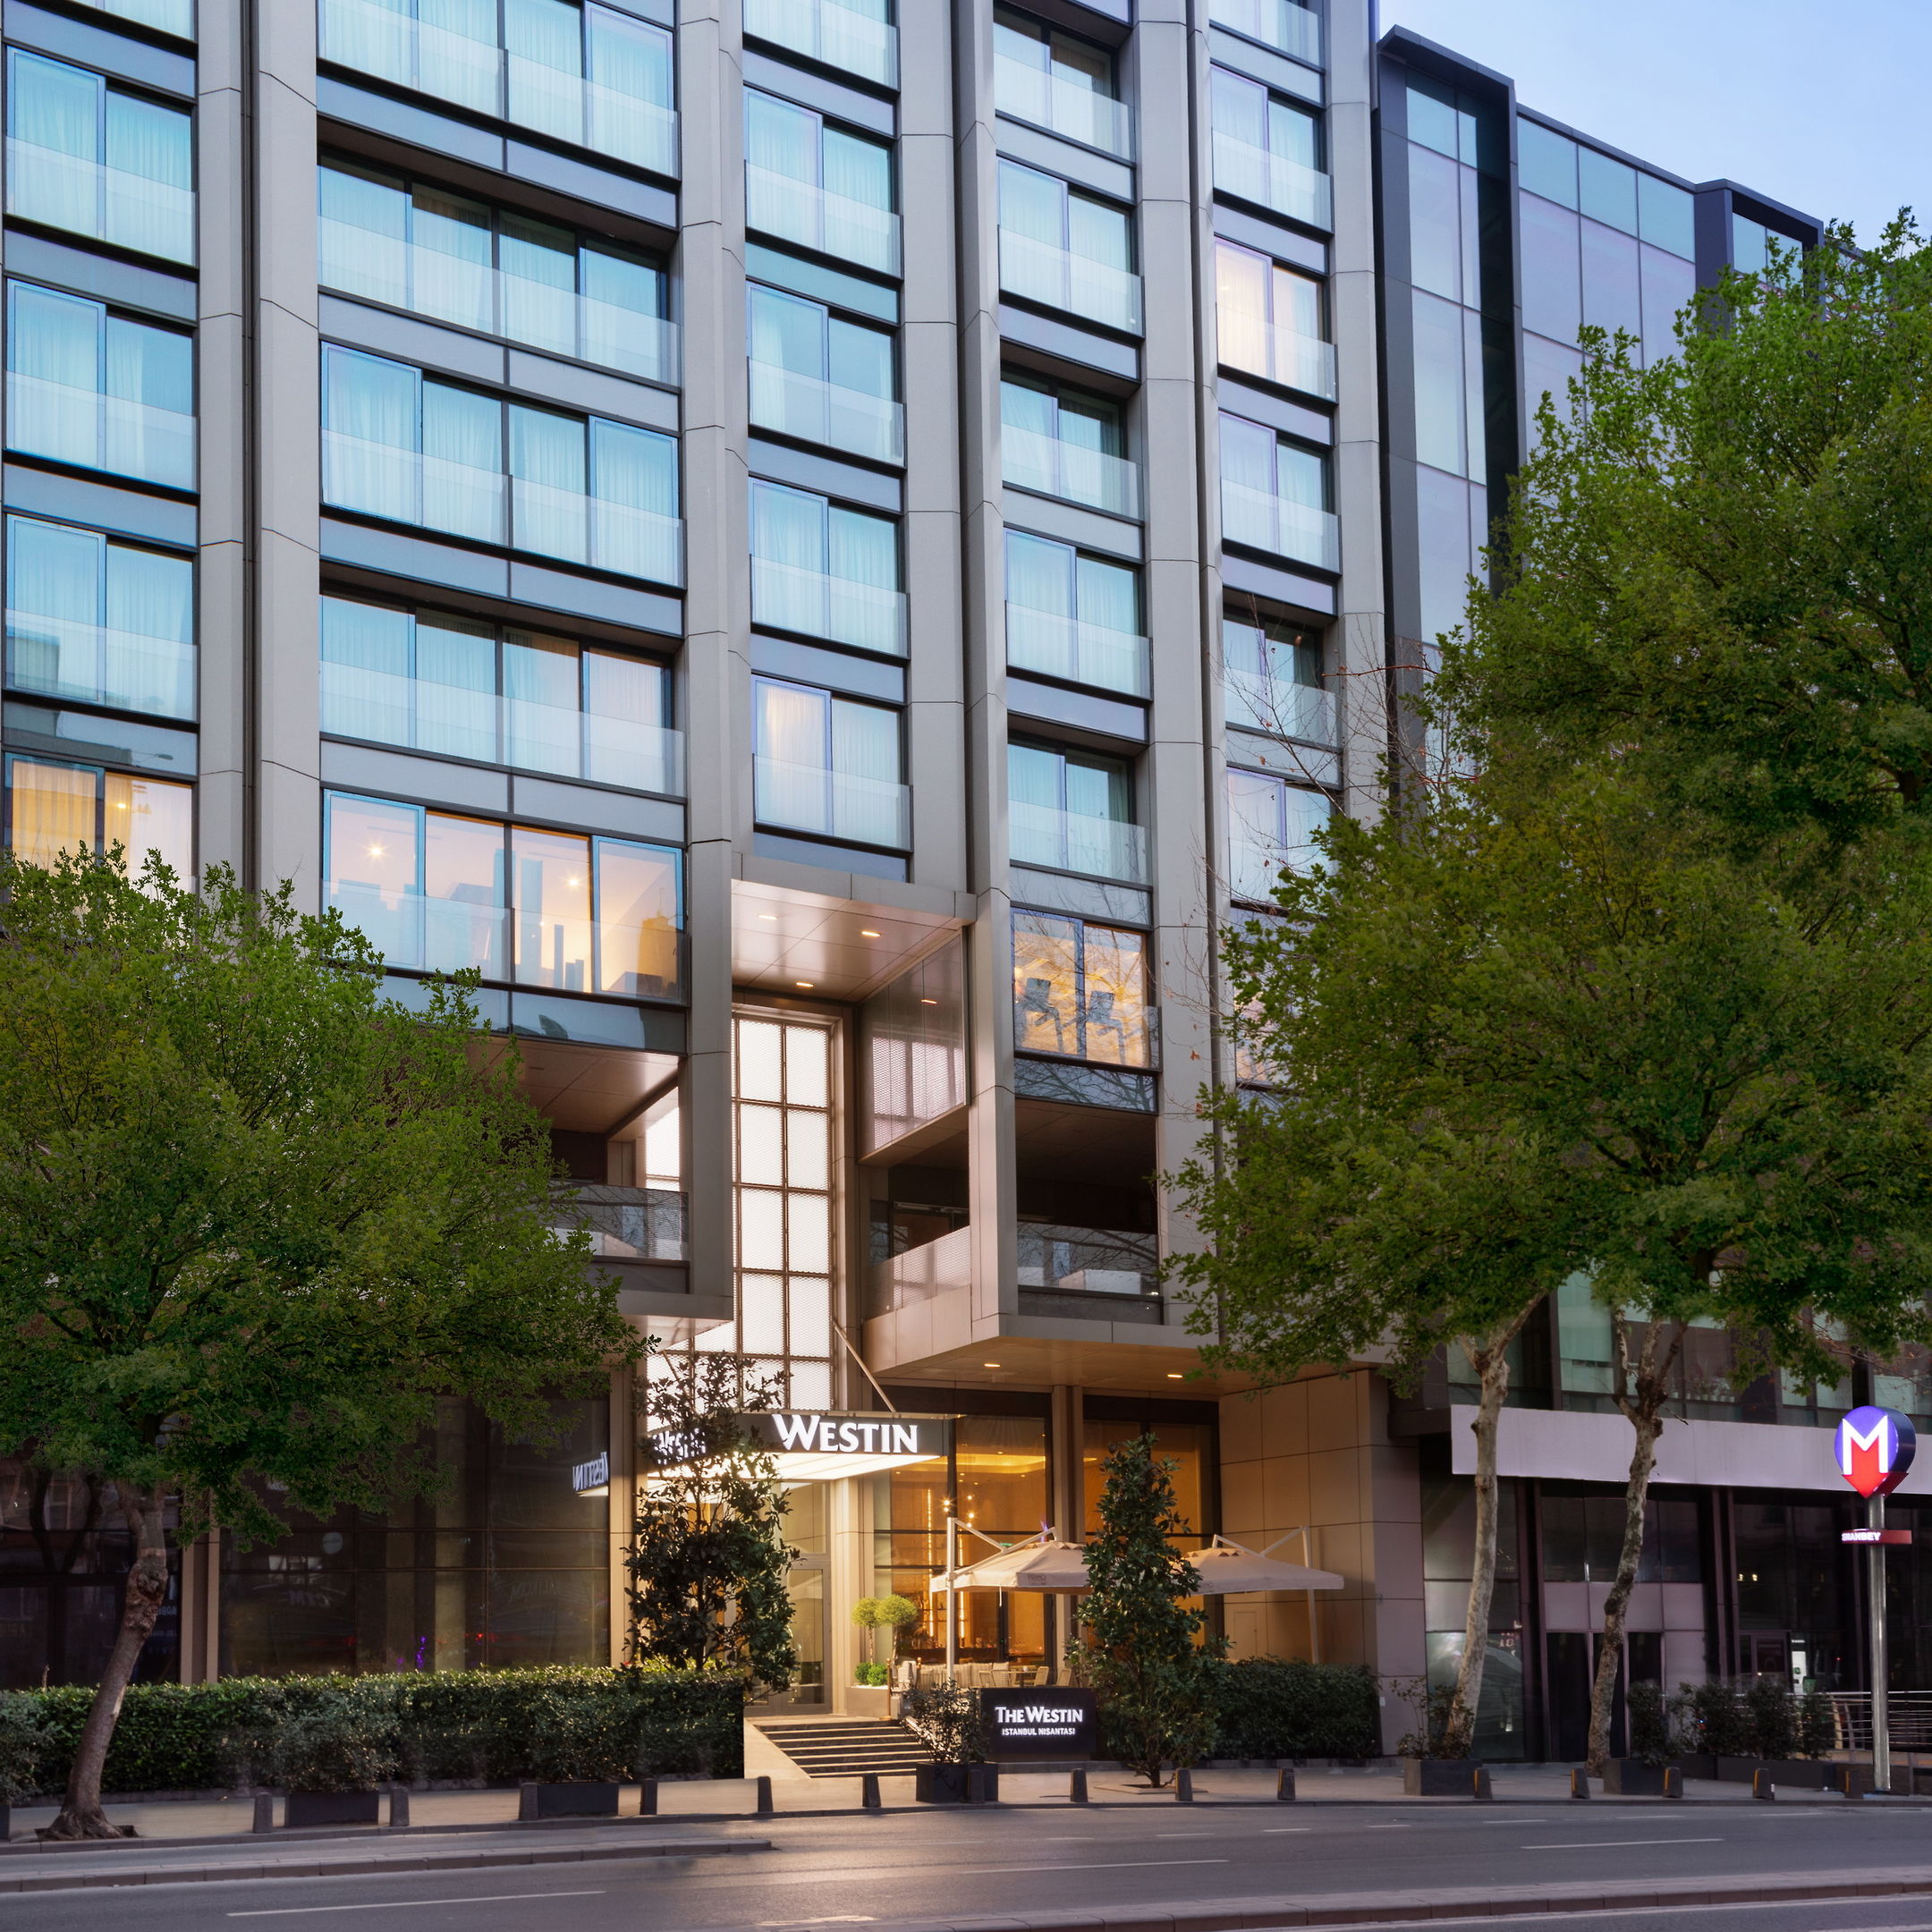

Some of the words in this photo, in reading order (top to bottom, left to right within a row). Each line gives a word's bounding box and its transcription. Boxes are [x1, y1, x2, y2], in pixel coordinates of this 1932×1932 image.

[772, 1413, 918, 1453] WESTIN
[1843, 1415, 1888, 1475] M
[995, 1707, 1025, 1723] THE
[1025, 1707, 1083, 1723] WESTIN
[1038, 1727, 1075, 1735] NISANTASI
